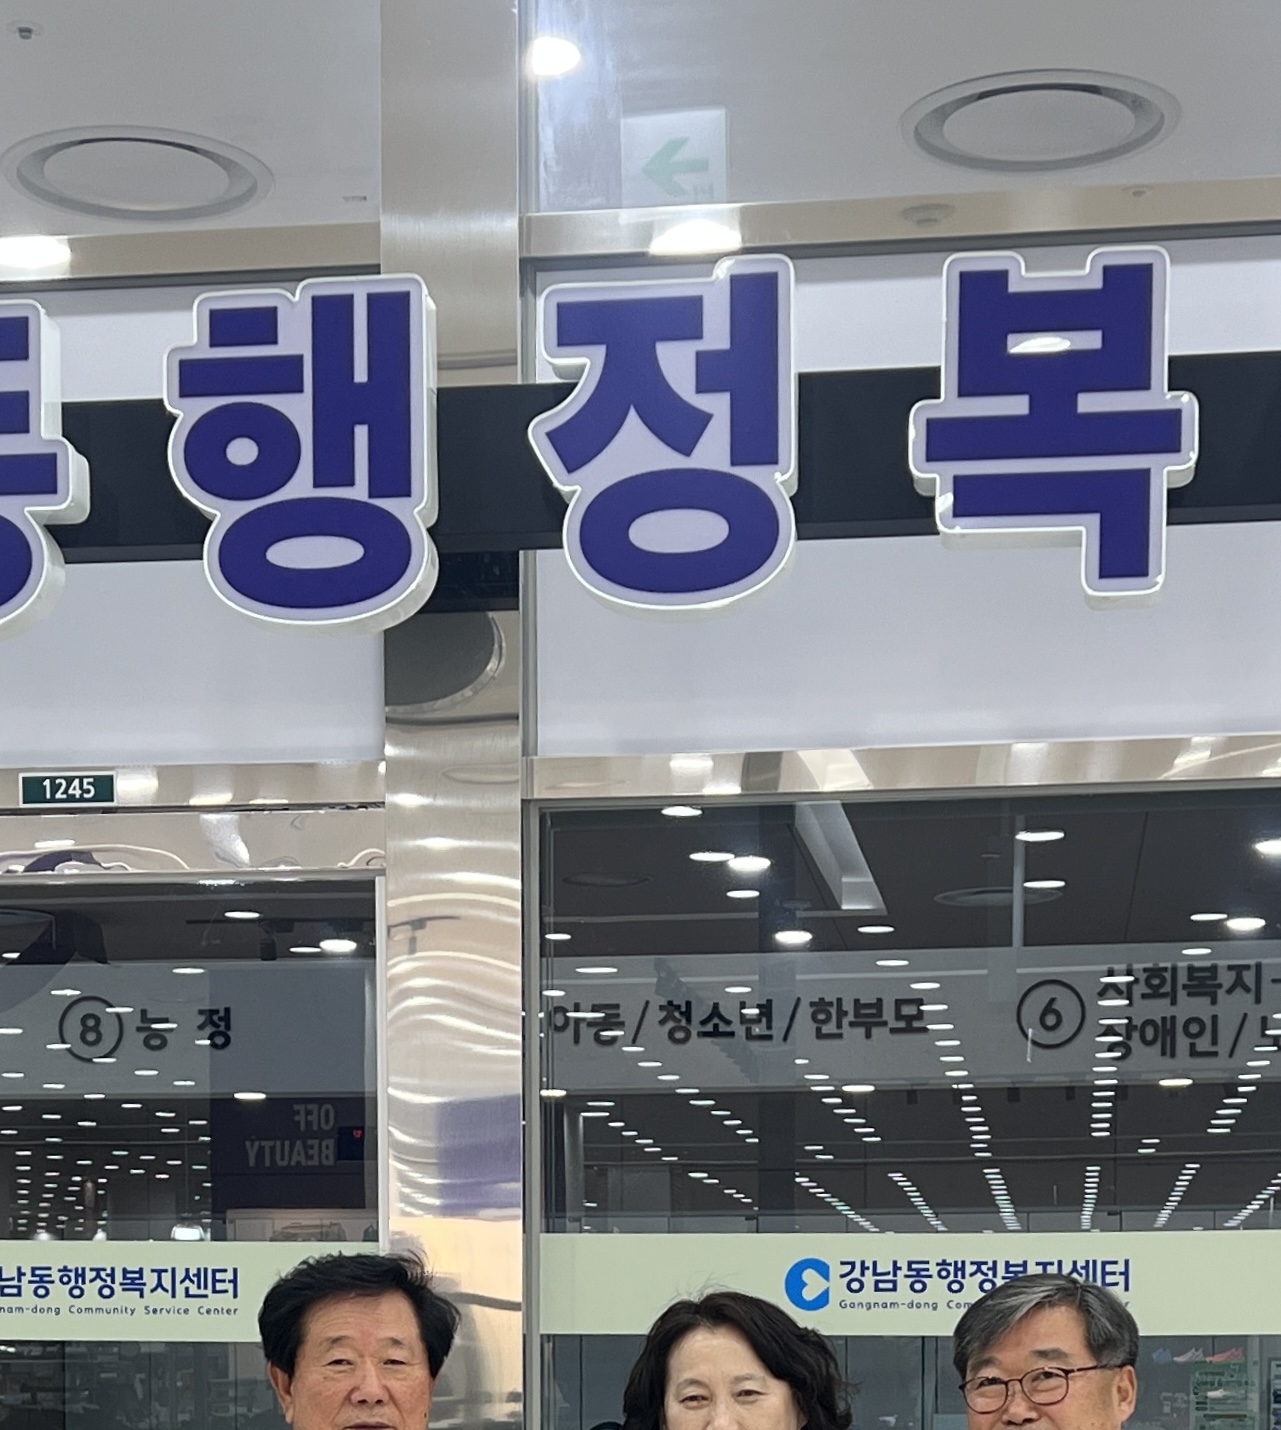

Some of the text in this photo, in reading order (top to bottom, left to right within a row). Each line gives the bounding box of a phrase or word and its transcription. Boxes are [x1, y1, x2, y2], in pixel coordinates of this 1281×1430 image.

[42, 776, 95, 800] 1245
[68, 1303, 135, 1317] Community
[143, 1303, 190, 1317] Service
[197, 1303, 239, 1317] Center
[839, 1298, 938, 1312] Gangnam-dong
